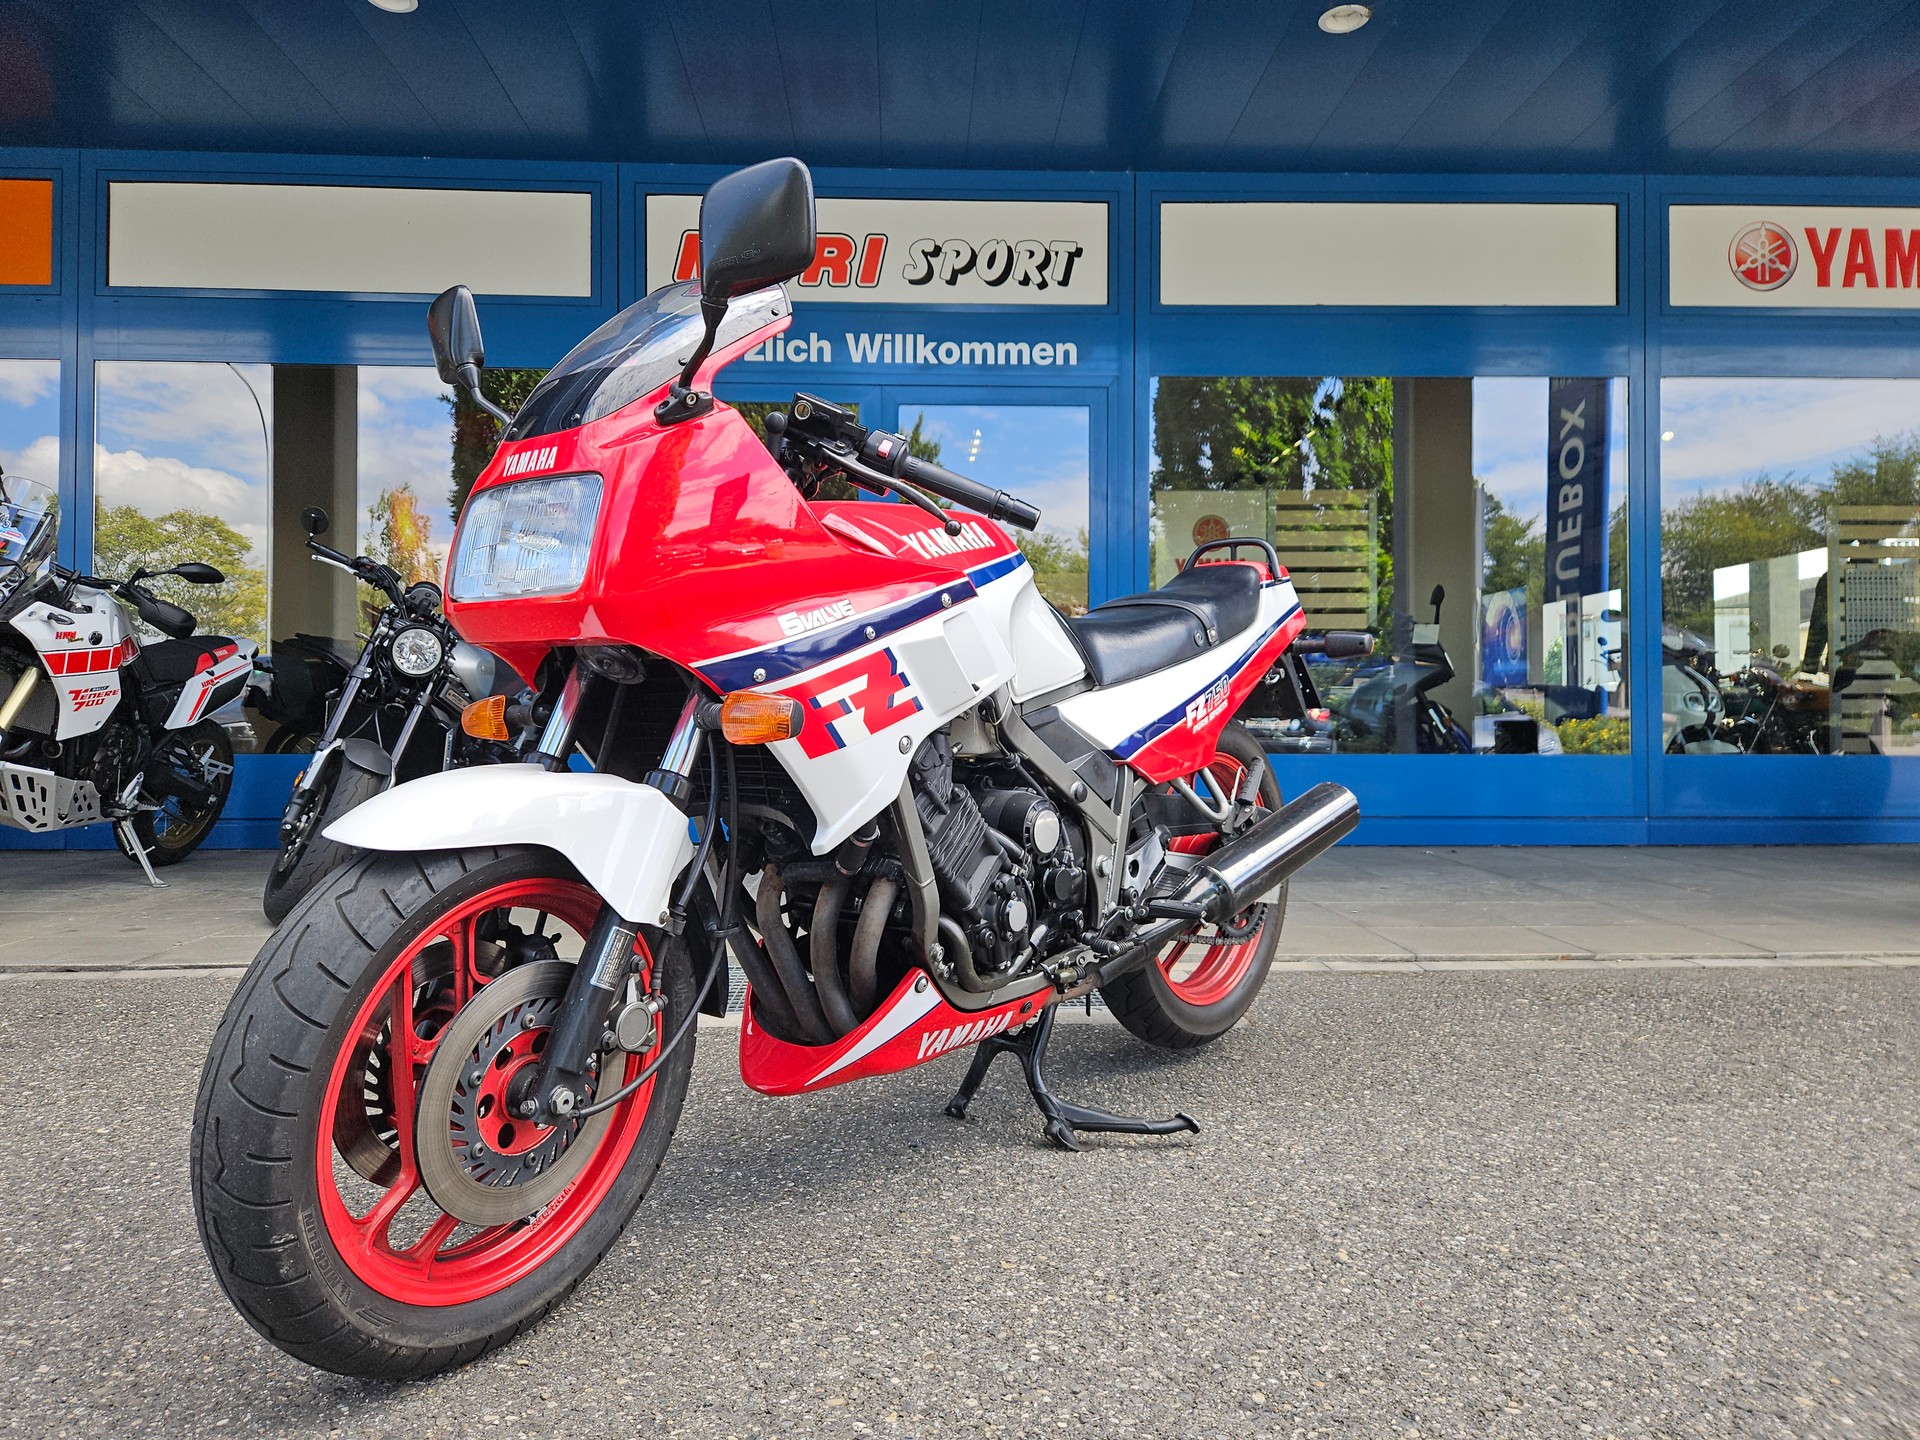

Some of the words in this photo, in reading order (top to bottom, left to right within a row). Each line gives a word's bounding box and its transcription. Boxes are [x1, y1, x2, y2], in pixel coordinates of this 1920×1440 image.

[902, 238, 1083, 290] SPORT
[1804, 227, 1920, 288] YAM
[743, 332, 832, 363] zlich
[845, 332, 1078, 366] Willkommen
[502, 446, 558, 478] YAMAHA
[73, 698, 105, 712] 700
[777, 646, 923, 760] FZ
[917, 1010, 1014, 1060] YAMAHA
